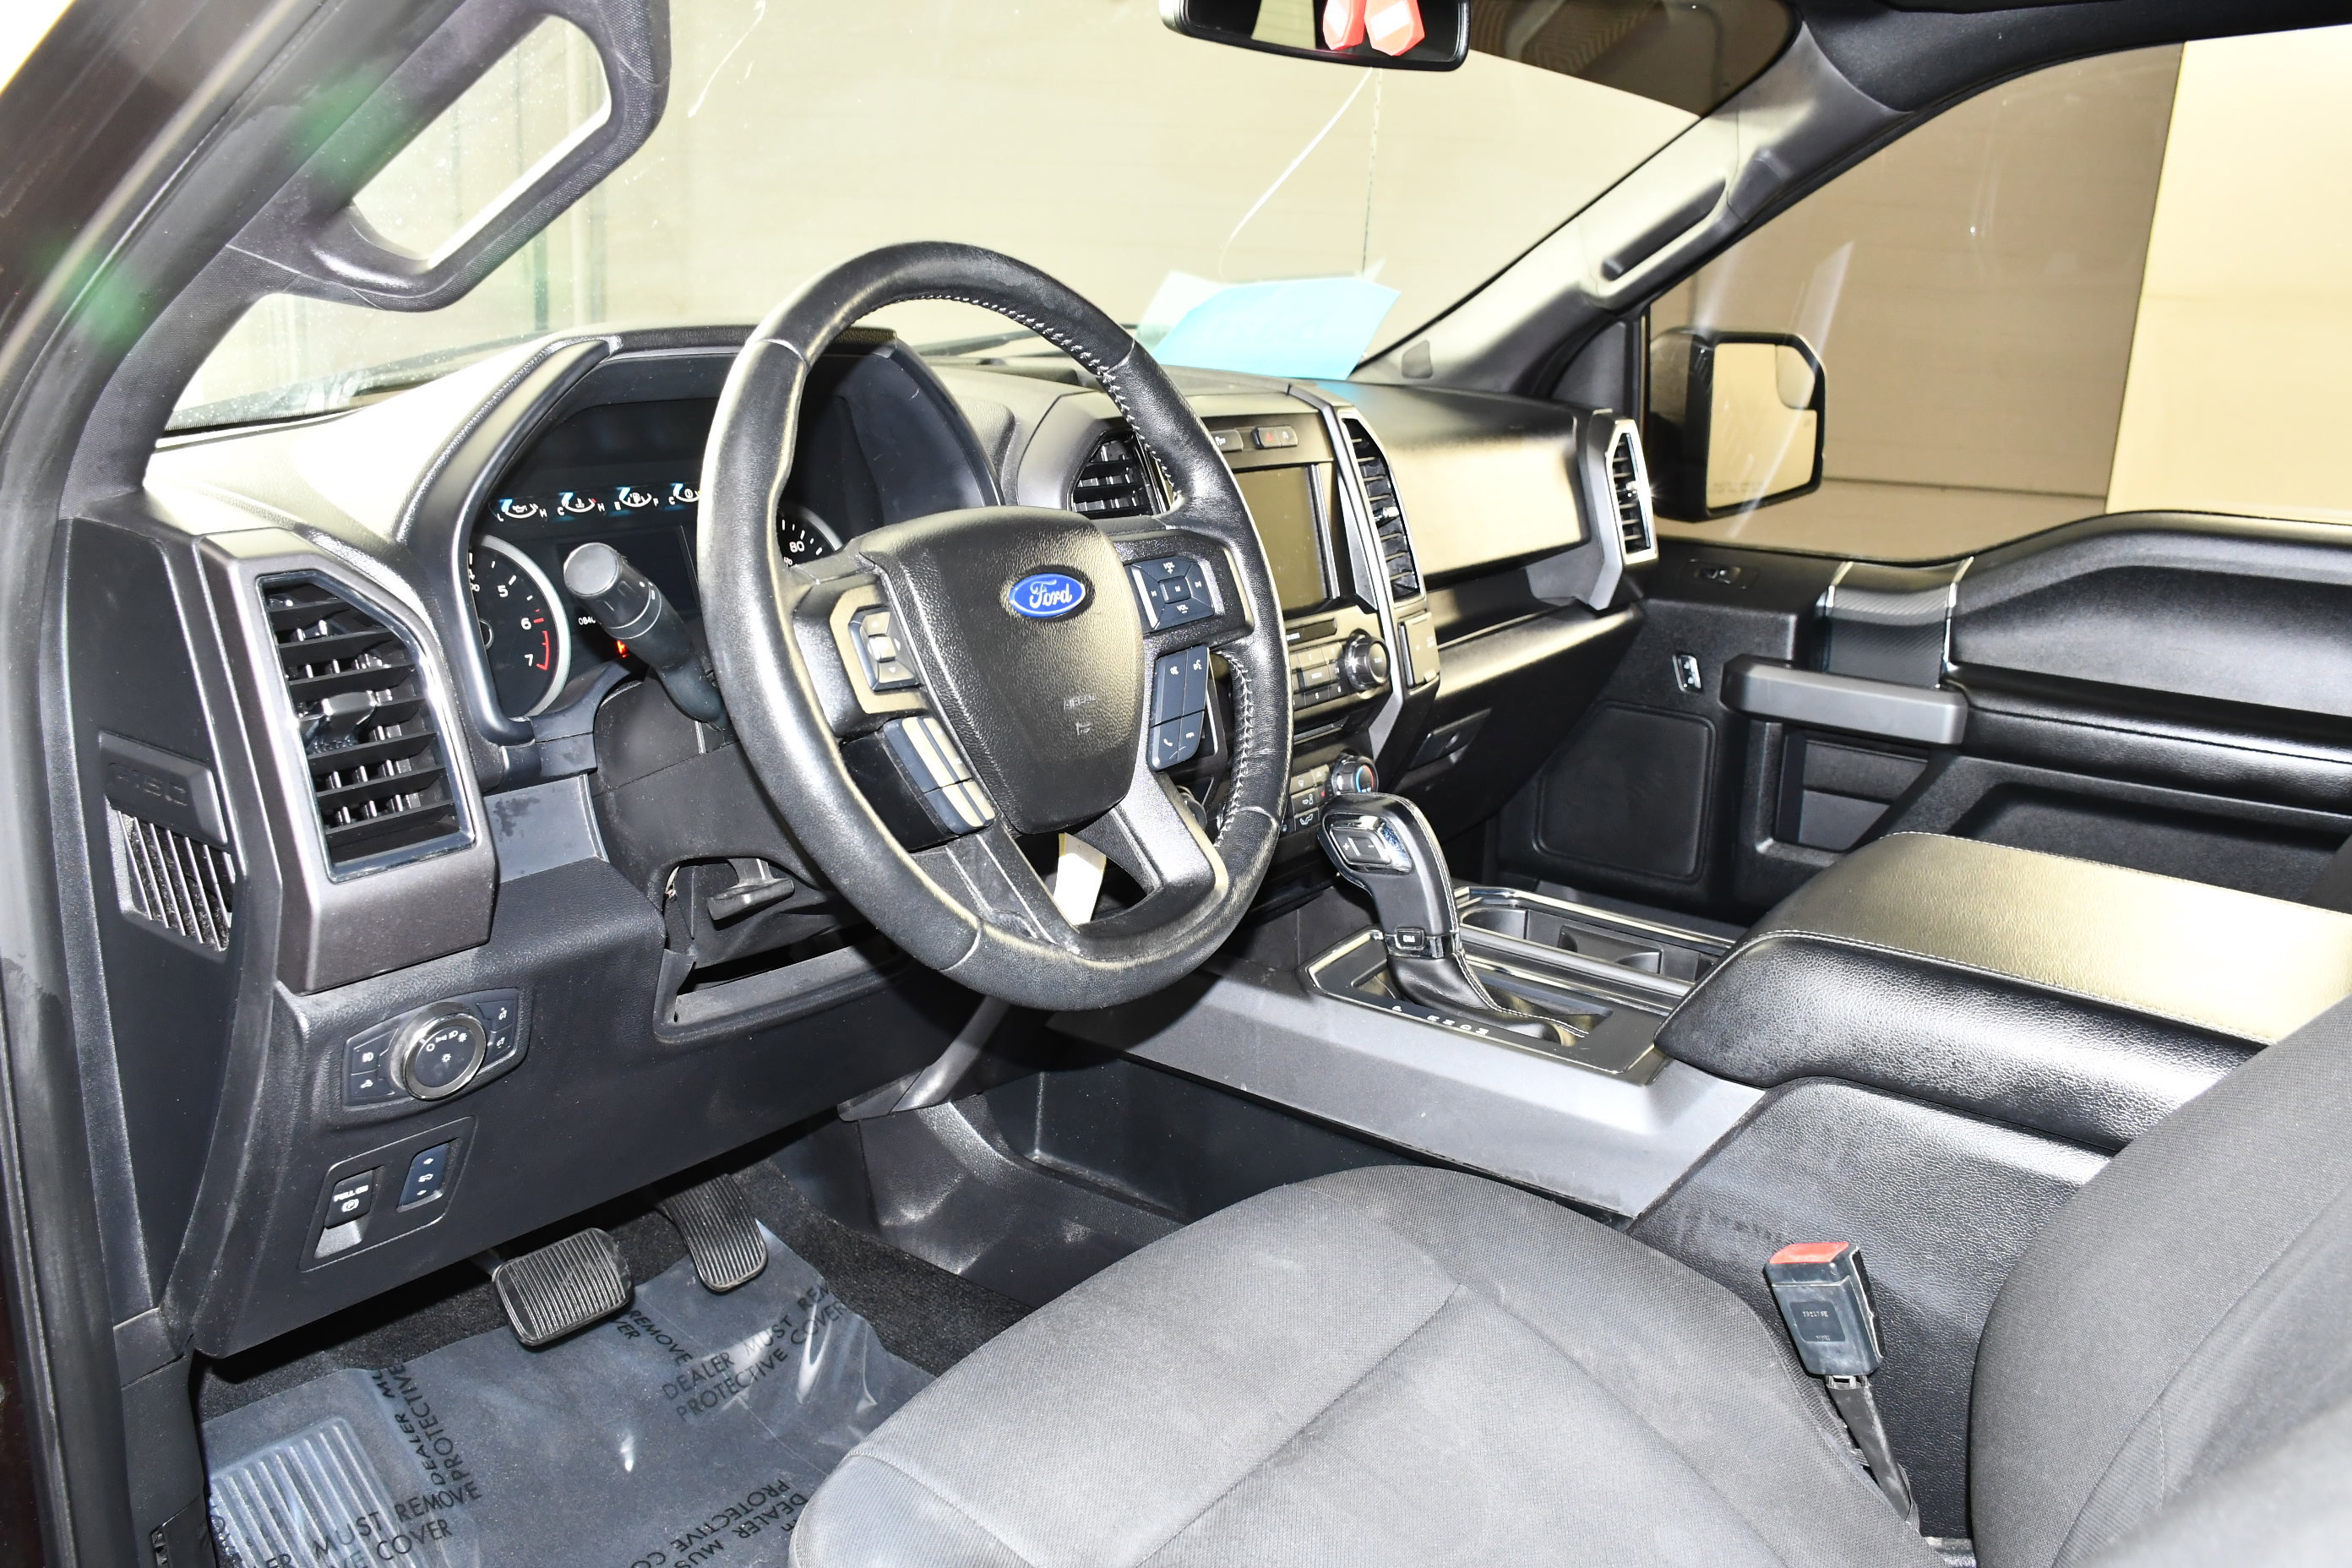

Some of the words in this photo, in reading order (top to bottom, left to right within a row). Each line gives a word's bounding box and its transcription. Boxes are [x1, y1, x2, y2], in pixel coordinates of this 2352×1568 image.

[558, 507, 565, 515] C
[789, 541, 805, 553] 80
[498, 585, 509, 597] 5
[1029, 580, 1073, 609] Ford
[520, 618, 532, 630] 6
[525, 654, 534, 667] 7
[630, 1309, 693, 1366] REMOVE
[662, 1352, 735, 1401] DEALER
[743, 1315, 793, 1357] MUST
[676, 1348, 788, 1423] PROTECTIVE
[790, 1299, 845, 1345] COVER
[387, 1364, 471, 1481] PROTECTIVE
[395, 1413, 446, 1486] DEALER
[313, 1511, 384, 1560] MUST
[395, 1481, 482, 1522] REMOVE
[671, 1479, 790, 1552] PROTECTIVE
[732, 1492, 808, 1539] DEALER
[377, 1519, 452, 1561] COVER
